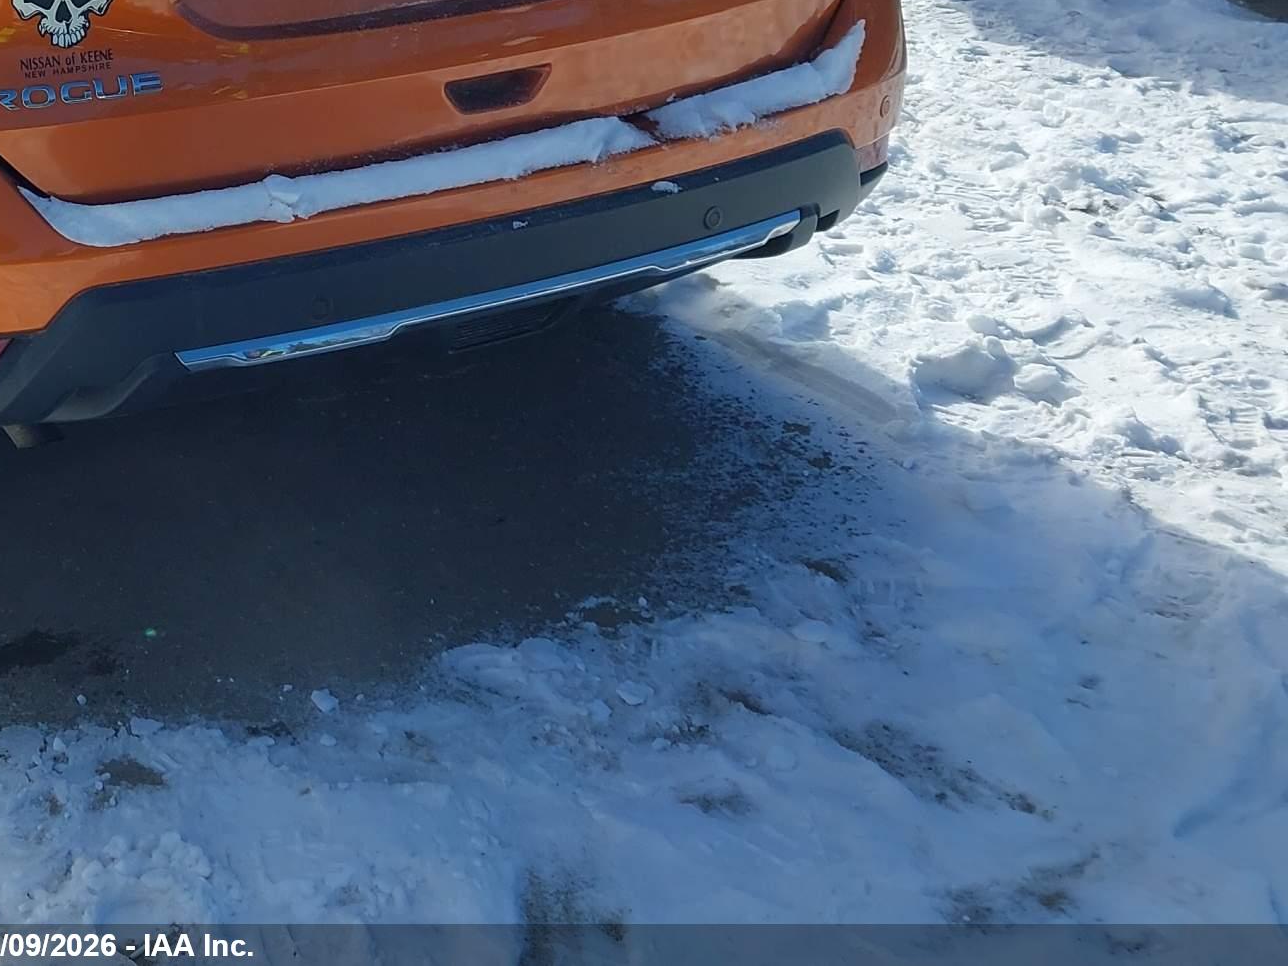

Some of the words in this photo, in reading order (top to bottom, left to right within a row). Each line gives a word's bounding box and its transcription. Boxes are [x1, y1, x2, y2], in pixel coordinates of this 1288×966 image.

[19, 55, 61, 71] NISSAN
[65, 52, 77, 66] of
[80, 48, 114, 63] KEENE
[24, 70, 46, 80] NEW
[52, 61, 112, 76] HAMPSHIRE
